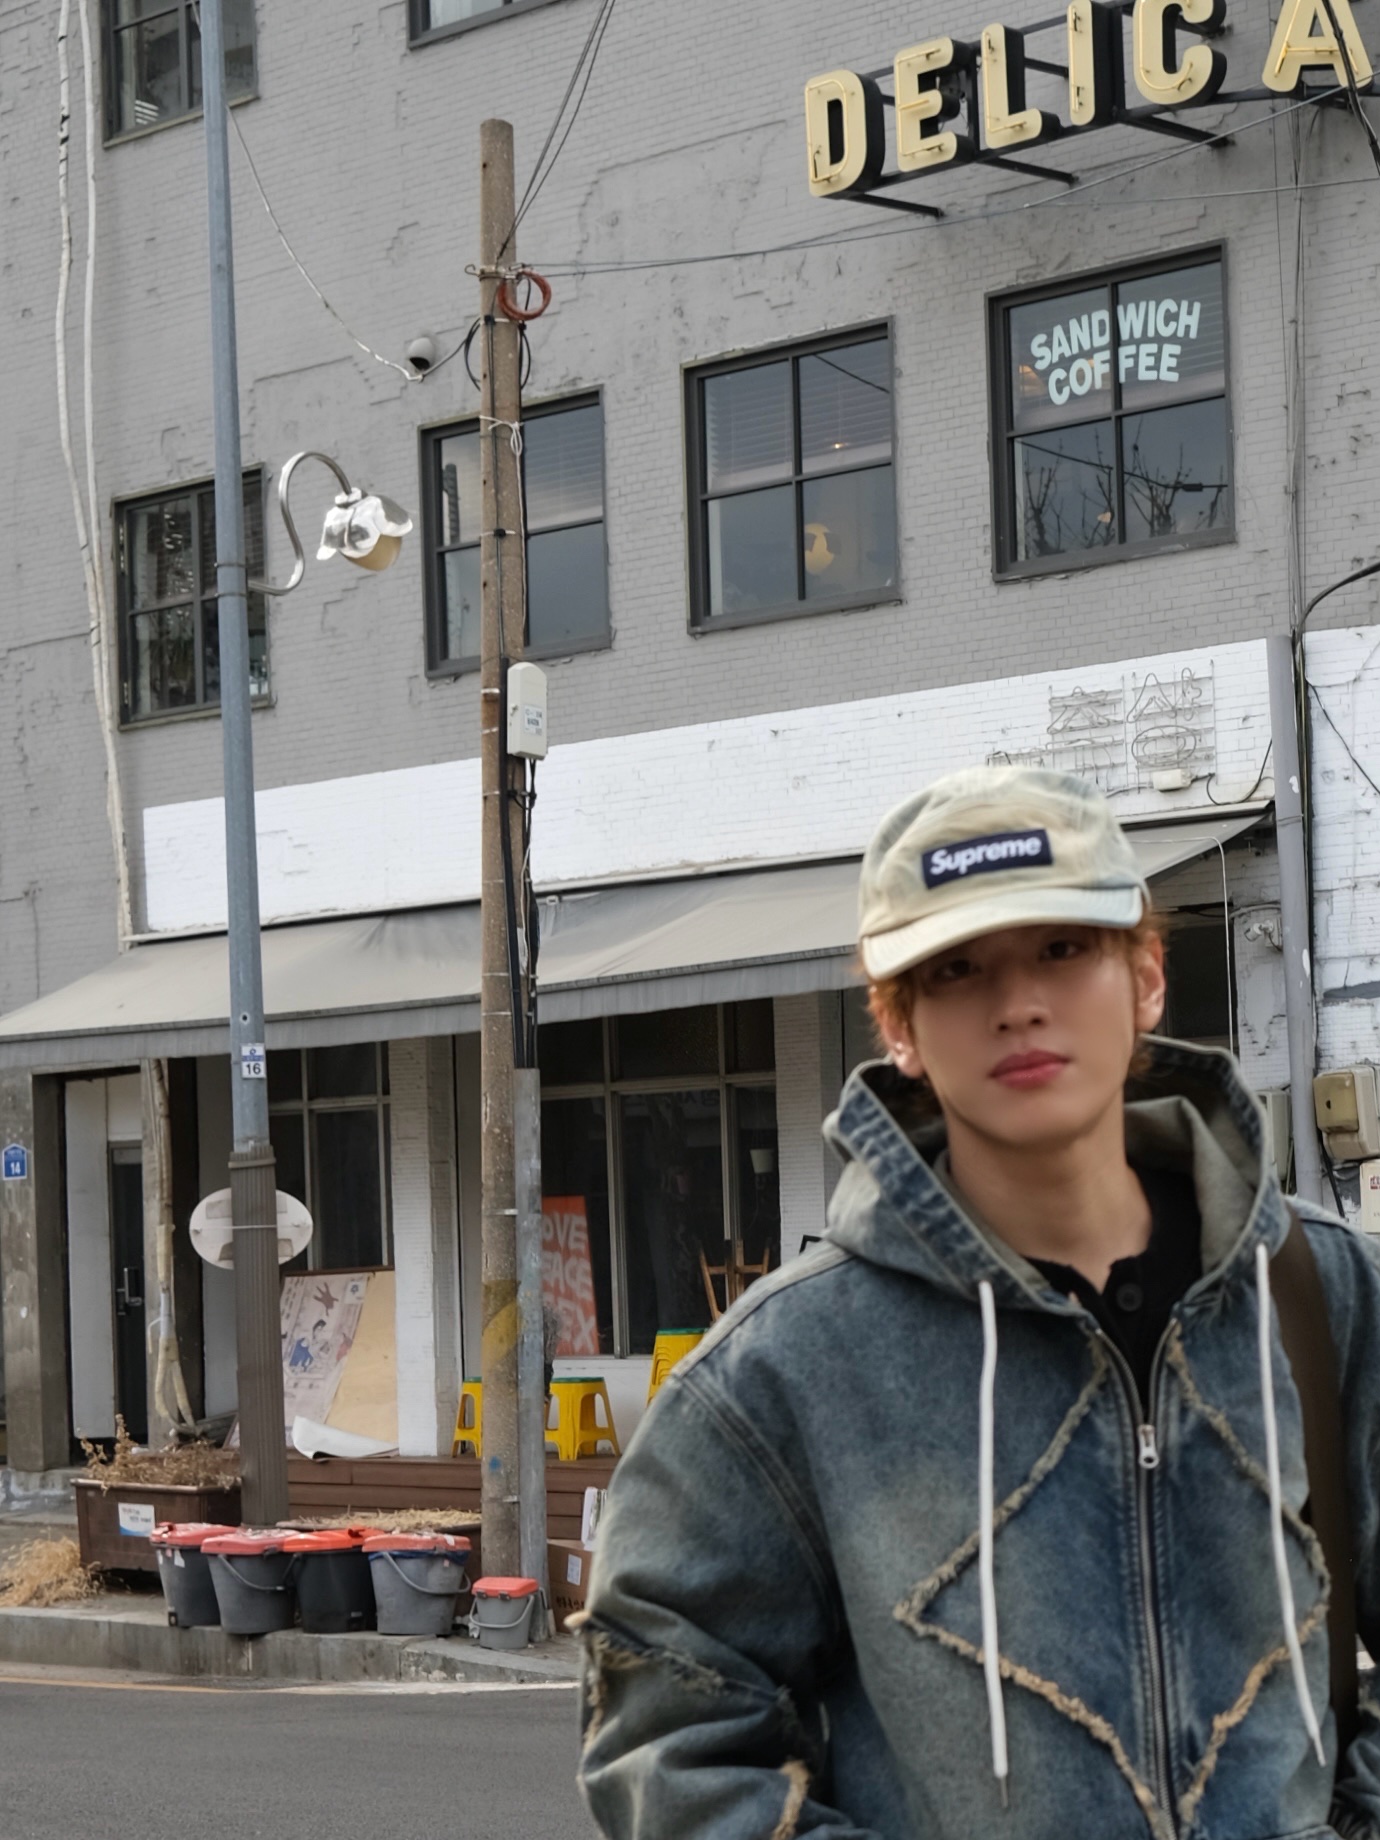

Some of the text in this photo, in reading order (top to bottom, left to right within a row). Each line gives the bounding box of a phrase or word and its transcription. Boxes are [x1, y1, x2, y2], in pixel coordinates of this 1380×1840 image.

[1030, 298, 1201, 371] SANDWICH
[1047, 343, 1182, 406] COFFEE
[929, 835, 1043, 876] Supreme
[246, 1062, 261, 1076] 16
[10, 1161, 21, 1175] 14
[542, 1211, 588, 1254] OVE
[542, 1251, 593, 1302] EACE
